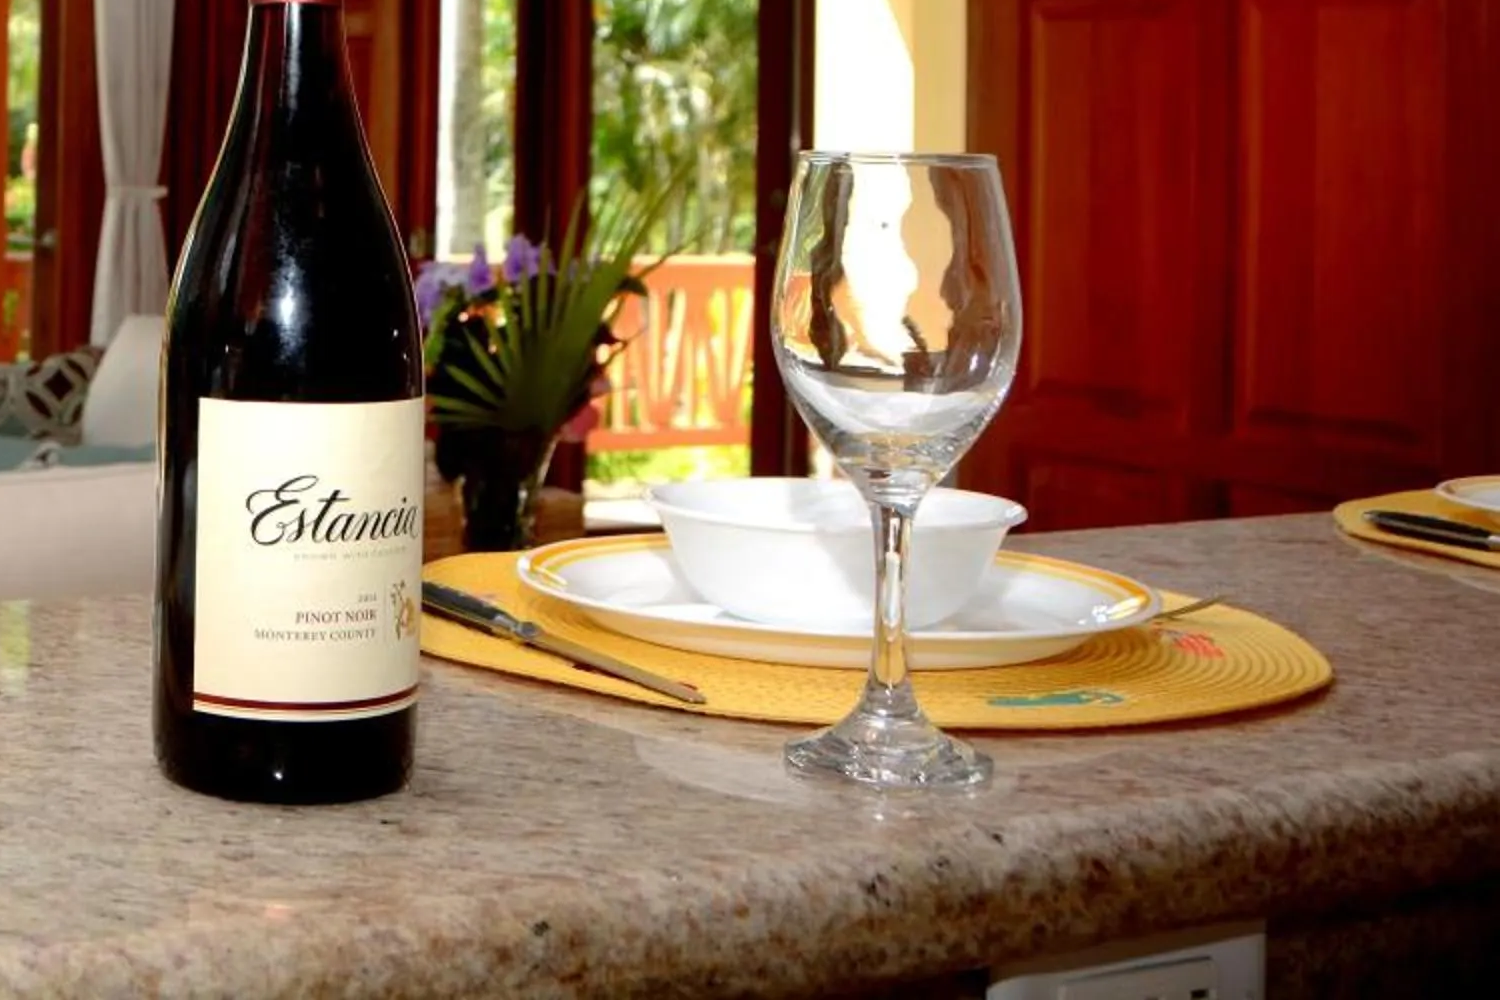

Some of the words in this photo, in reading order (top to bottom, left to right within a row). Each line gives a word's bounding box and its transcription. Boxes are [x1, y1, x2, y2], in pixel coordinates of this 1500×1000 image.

[245, 475, 419, 546] Estancia
[295, 611, 342, 625] PINOT
[345, 609, 377, 622] NOIR
[254, 627, 327, 642] MONTEREY
[329, 627, 376, 641] COUNTY
